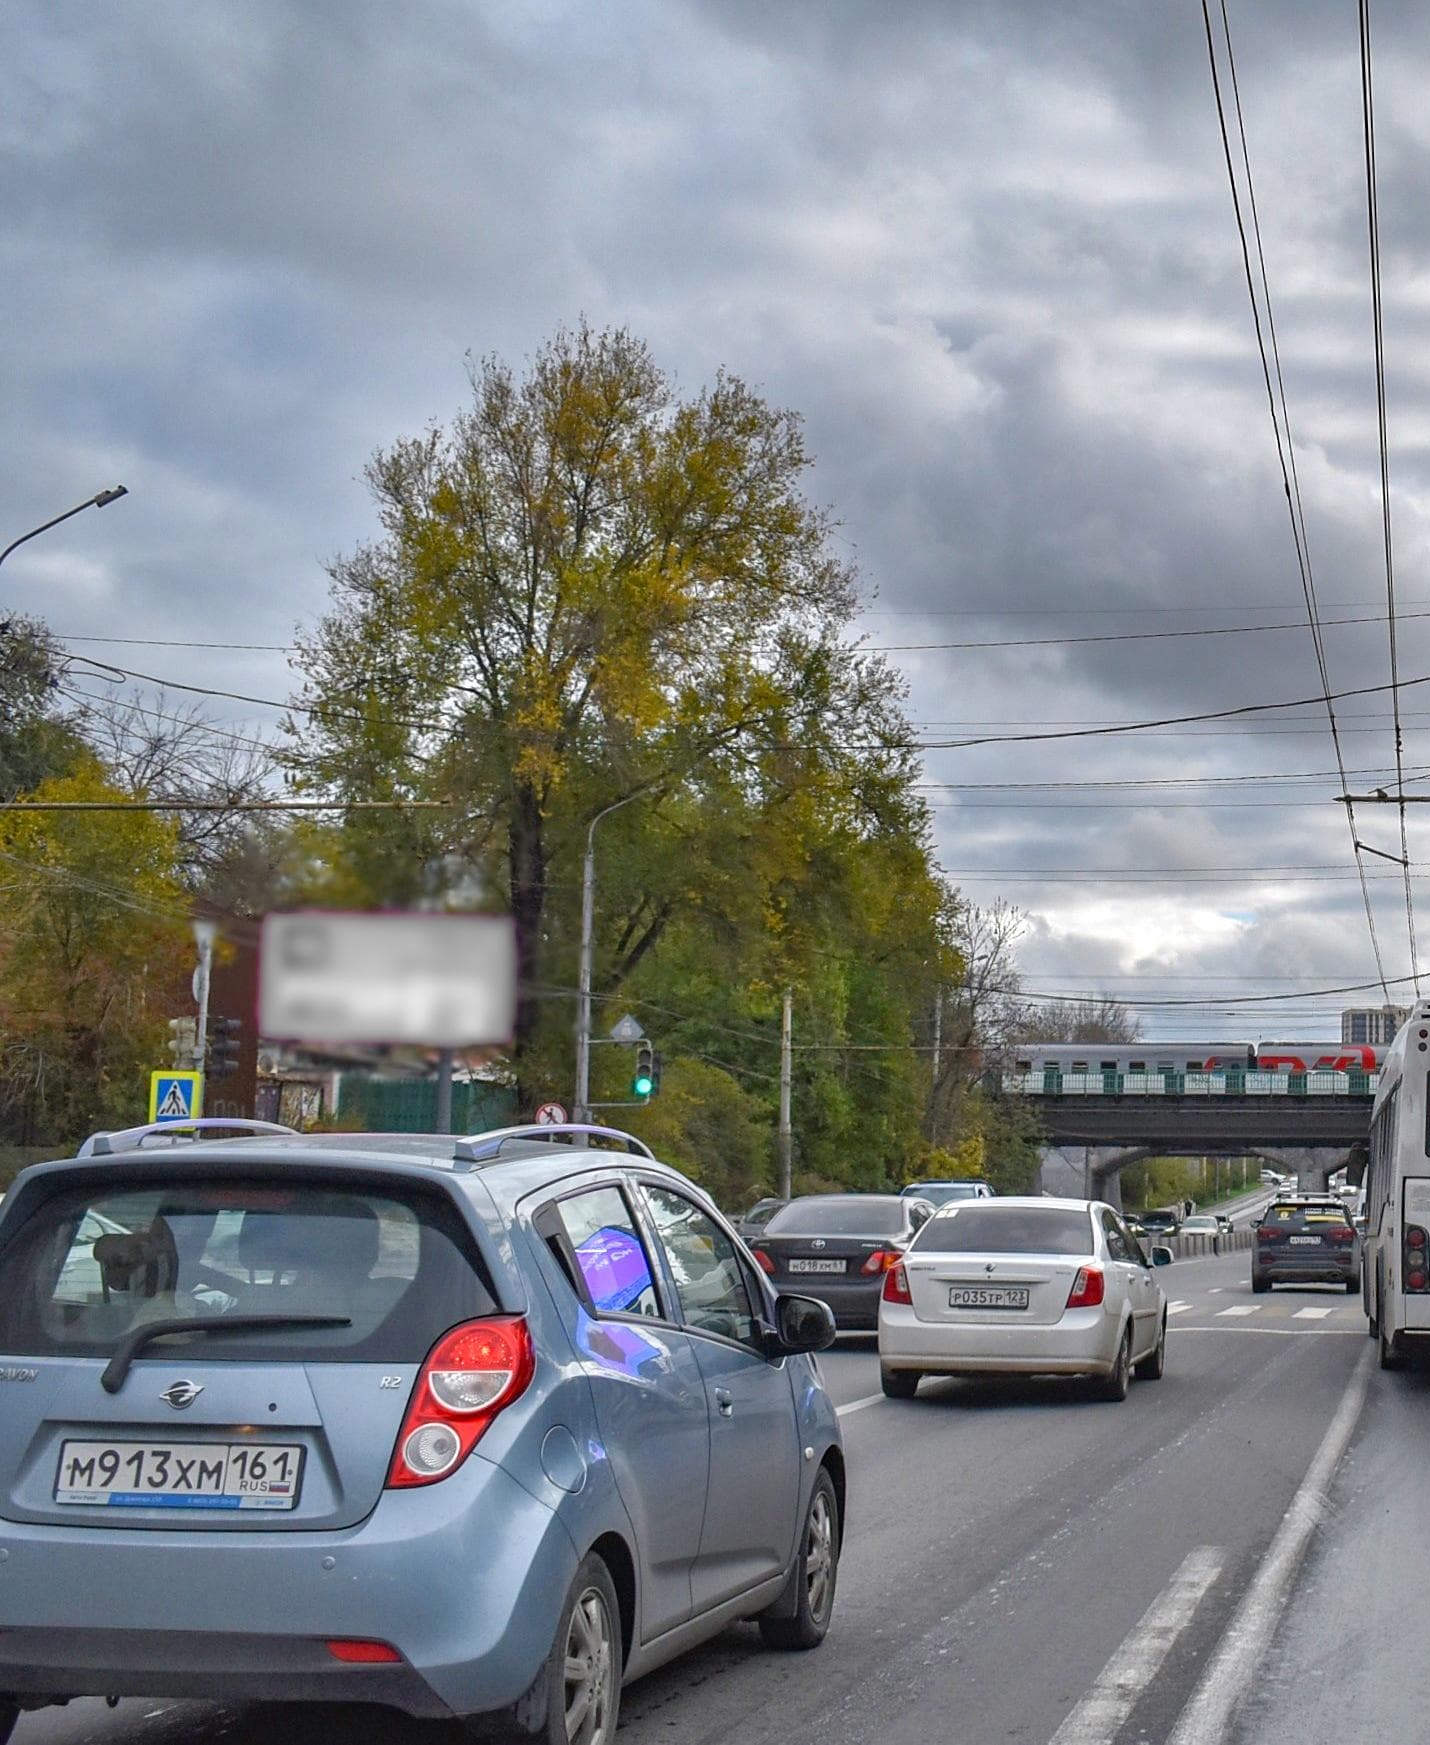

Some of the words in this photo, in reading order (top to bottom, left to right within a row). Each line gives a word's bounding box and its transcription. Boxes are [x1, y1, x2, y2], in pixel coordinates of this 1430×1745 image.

[954, 1291, 1003, 1304] Р035ТР
[1006, 1291, 1025, 1301] 123
[380, 1375, 402, 1389] R2
[69, 1449, 224, 1490] М913ХМ
[232, 1450, 290, 1481] 161
[240, 1481, 268, 1492] RUS
